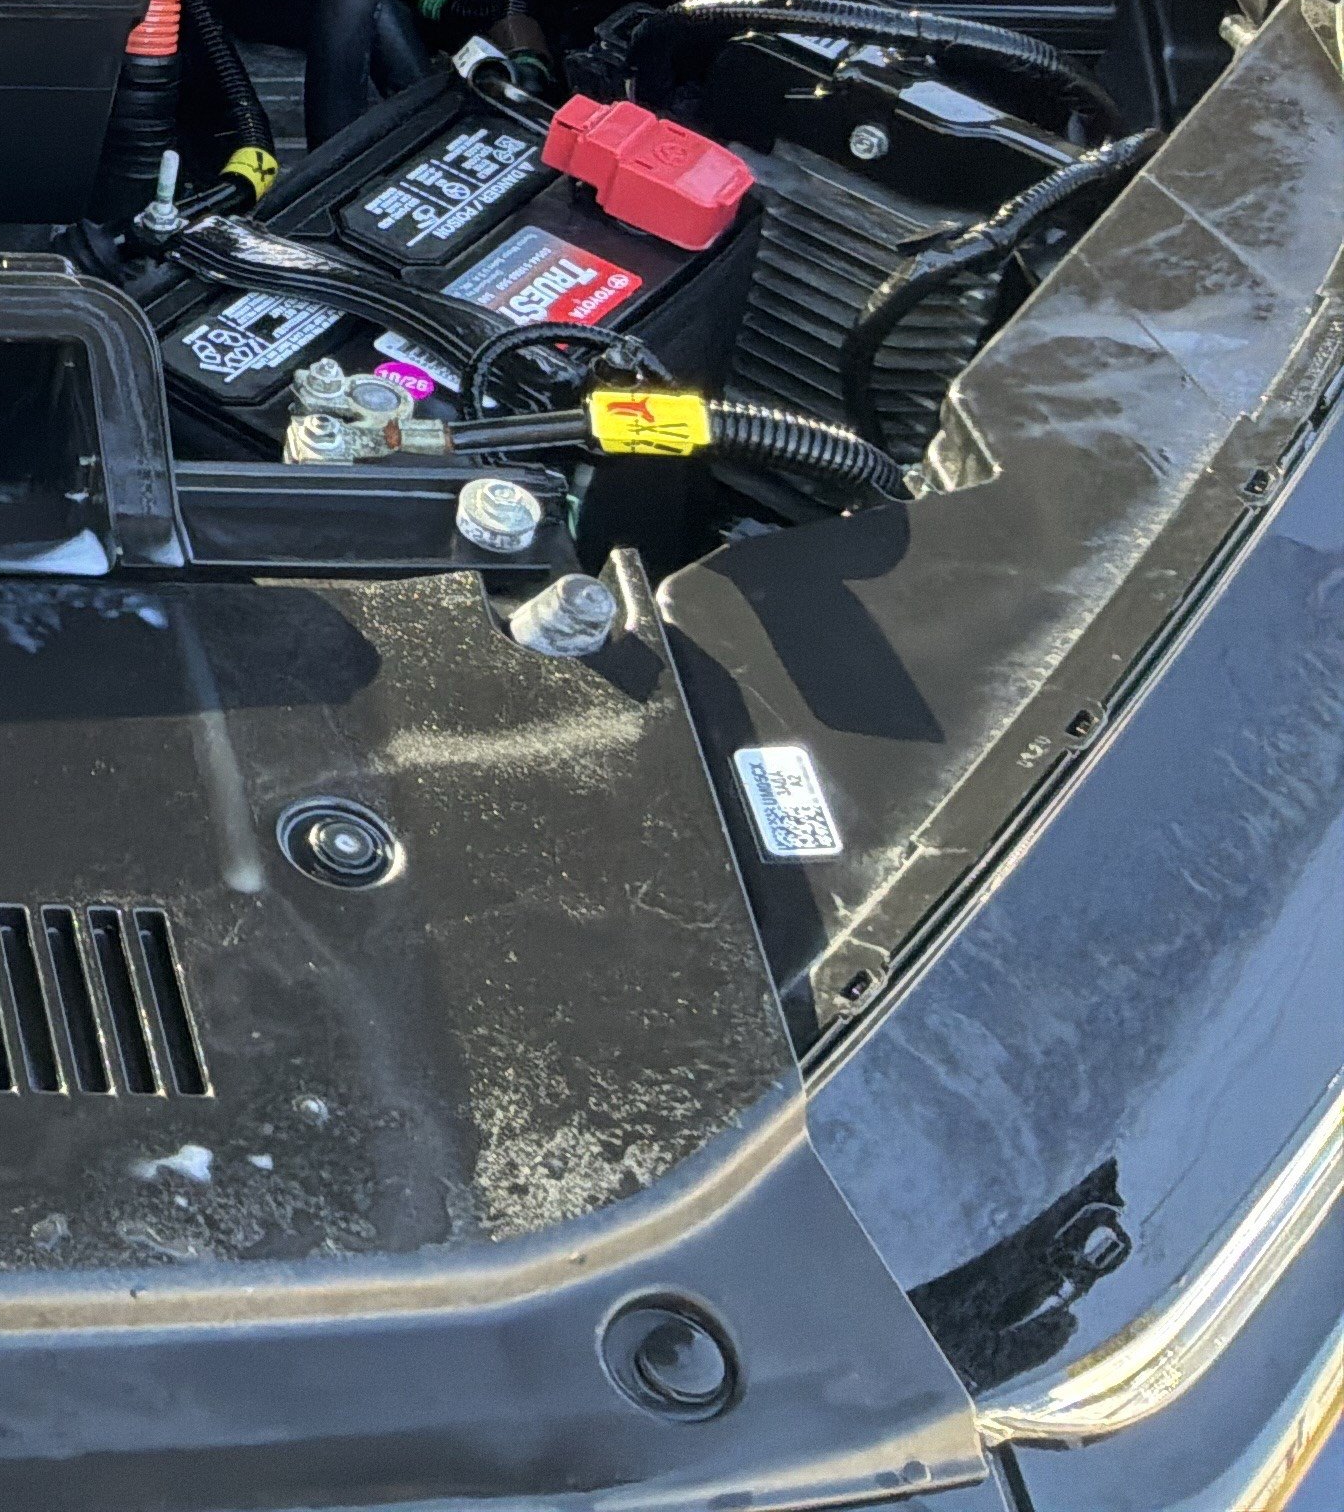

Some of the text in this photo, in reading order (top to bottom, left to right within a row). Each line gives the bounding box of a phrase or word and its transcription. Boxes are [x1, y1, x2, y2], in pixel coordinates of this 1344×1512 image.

[479, 168, 525, 205] DANGER
[431, 206, 477, 240] POISON
[497, 258, 599, 326] TRUEST
[568, 285, 615, 319] TOYOTA
